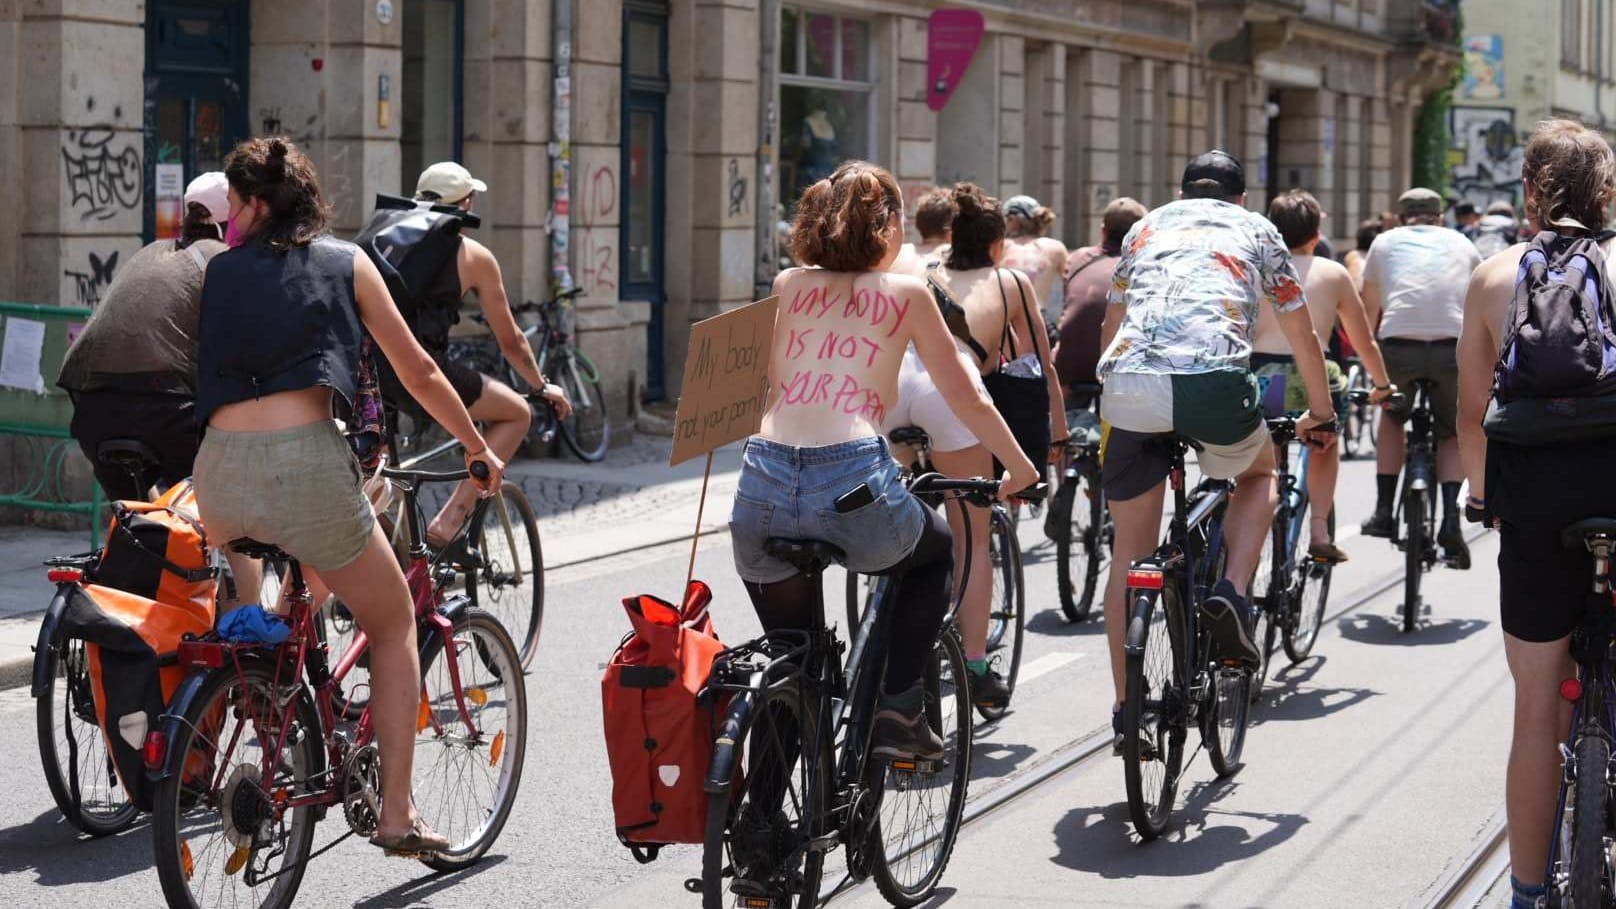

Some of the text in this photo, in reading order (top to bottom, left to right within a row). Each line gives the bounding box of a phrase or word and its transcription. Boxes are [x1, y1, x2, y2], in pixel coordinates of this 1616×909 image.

[787, 286, 841, 319] MY
[690, 319, 761, 391] My body
[785, 329, 886, 368] IS NOT
[775, 370, 833, 412] YOUR
[676, 401, 699, 444] not
[702, 406, 728, 446] your
